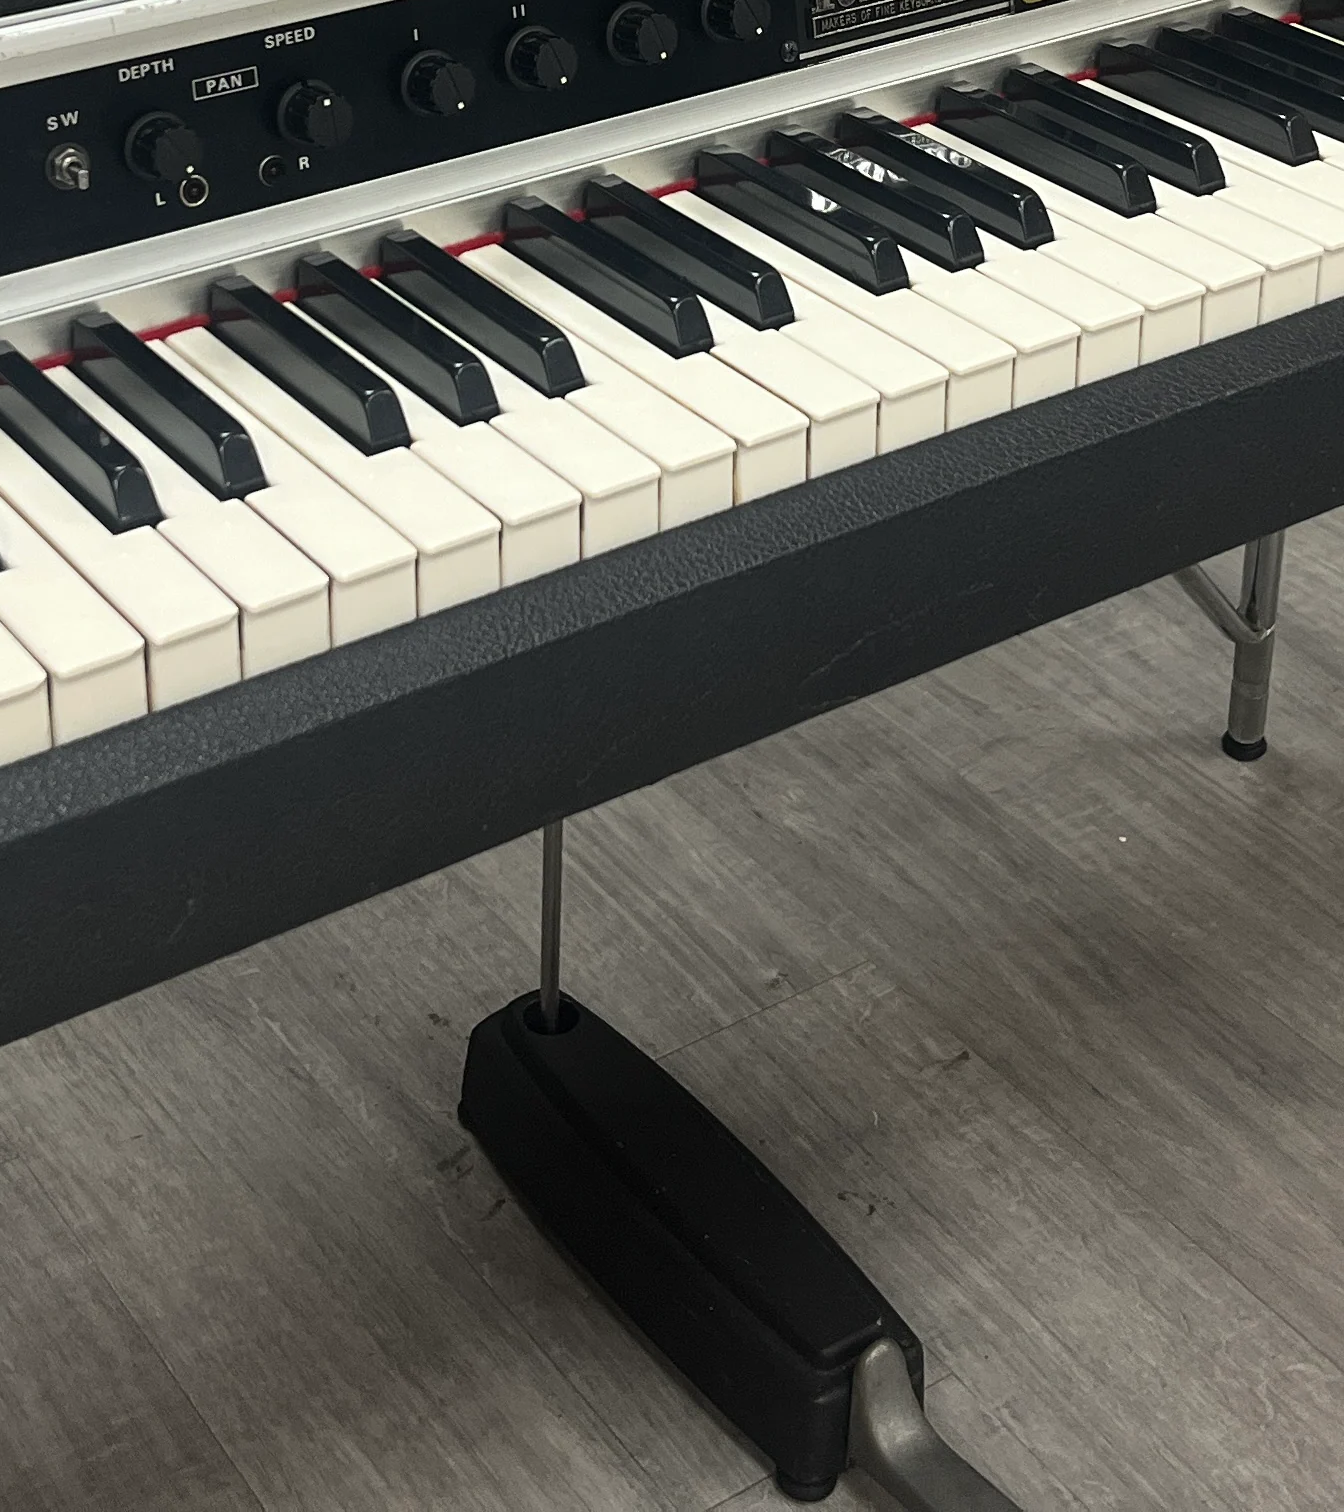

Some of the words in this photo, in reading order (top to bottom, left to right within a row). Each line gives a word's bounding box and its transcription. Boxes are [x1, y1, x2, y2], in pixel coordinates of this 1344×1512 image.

[821, 15, 857, 32] MAKERS
[861, 9, 872, 22] OF
[875, 4, 896, 19] FINE
[264, 27, 315, 49] SPEED
[118, 59, 174, 83] DEPTH
[205, 74, 243, 94] PAN
[298, 156, 310, 170] R
[155, 193, 166, 207] L
